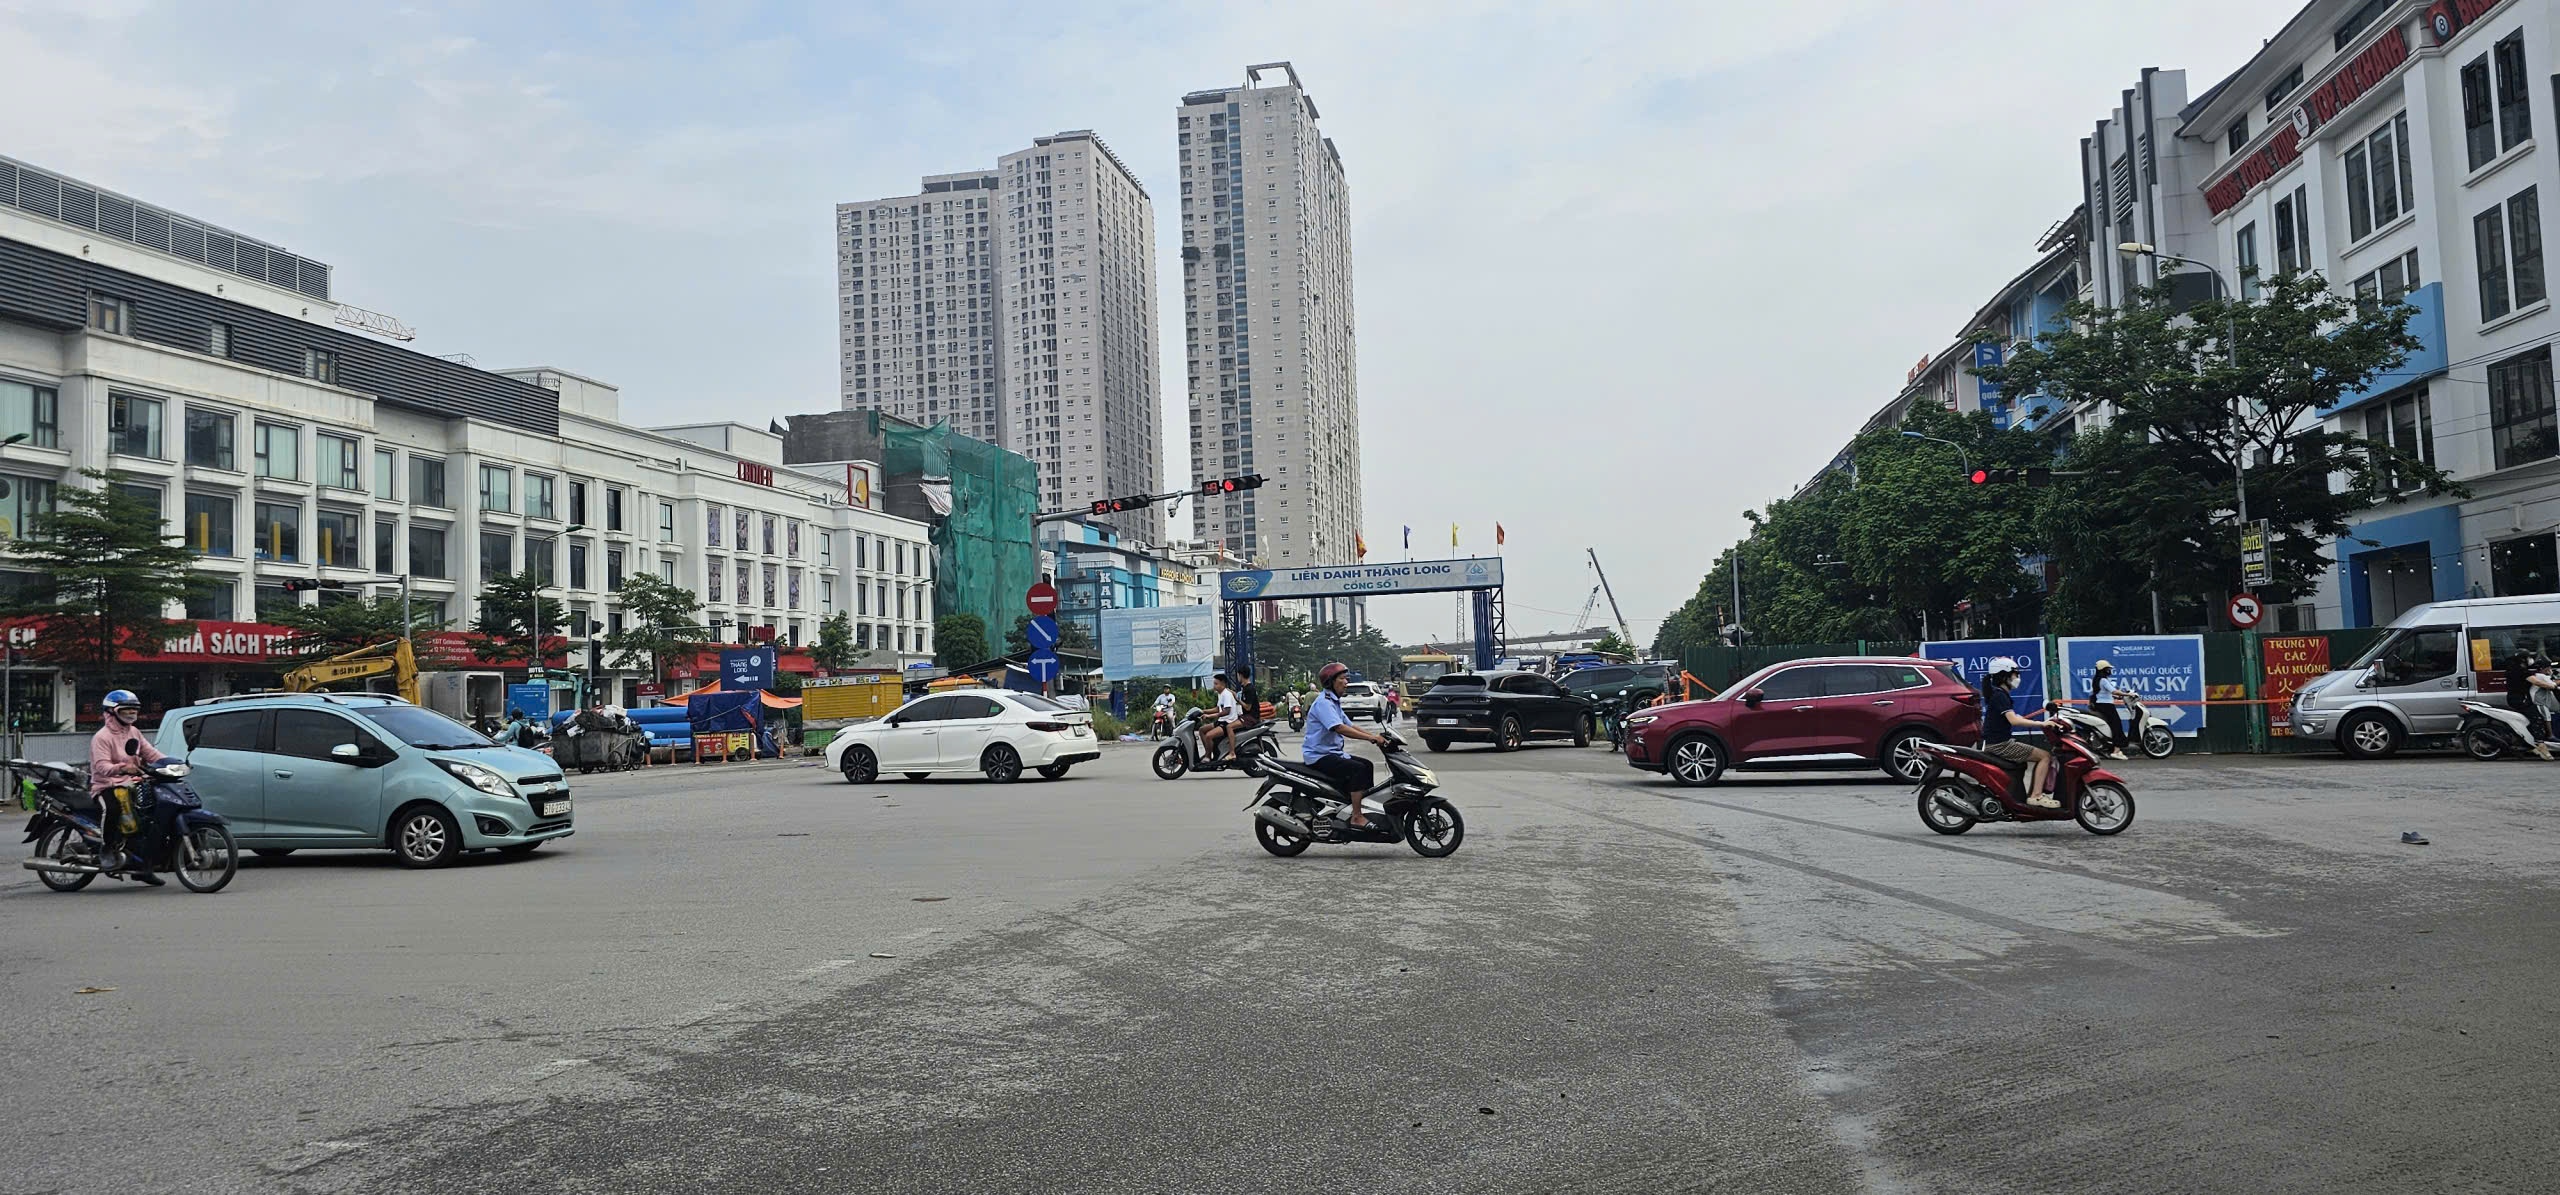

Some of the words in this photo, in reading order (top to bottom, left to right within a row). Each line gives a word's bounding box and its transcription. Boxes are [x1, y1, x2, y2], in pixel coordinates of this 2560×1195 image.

[2309, 78, 2339, 126] TOP
[1291, 570, 1320, 581] LIÊN
[1323, 569, 1362, 580] DANH
[1364, 565, 1411, 577] THĂNG
[1414, 564, 1451, 575] LONG
[1376, 578, 1392, 589] SỐ
[1394, 580, 1399, 588] 1
[164, 627, 205, 654] NHÀ
[210, 628, 260, 656] SÁCH
[2269, 639, 2305, 649] TRUNG
[2077, 666, 2089, 678] HỆ
[2118, 668, 2137, 676] ANH
[2158, 664, 2181, 676] QUỐC
[2183, 663, 2193, 675] TẾ
[2082, 676, 2150, 693] DEAM
[2155, 675, 2190, 692] SKY
